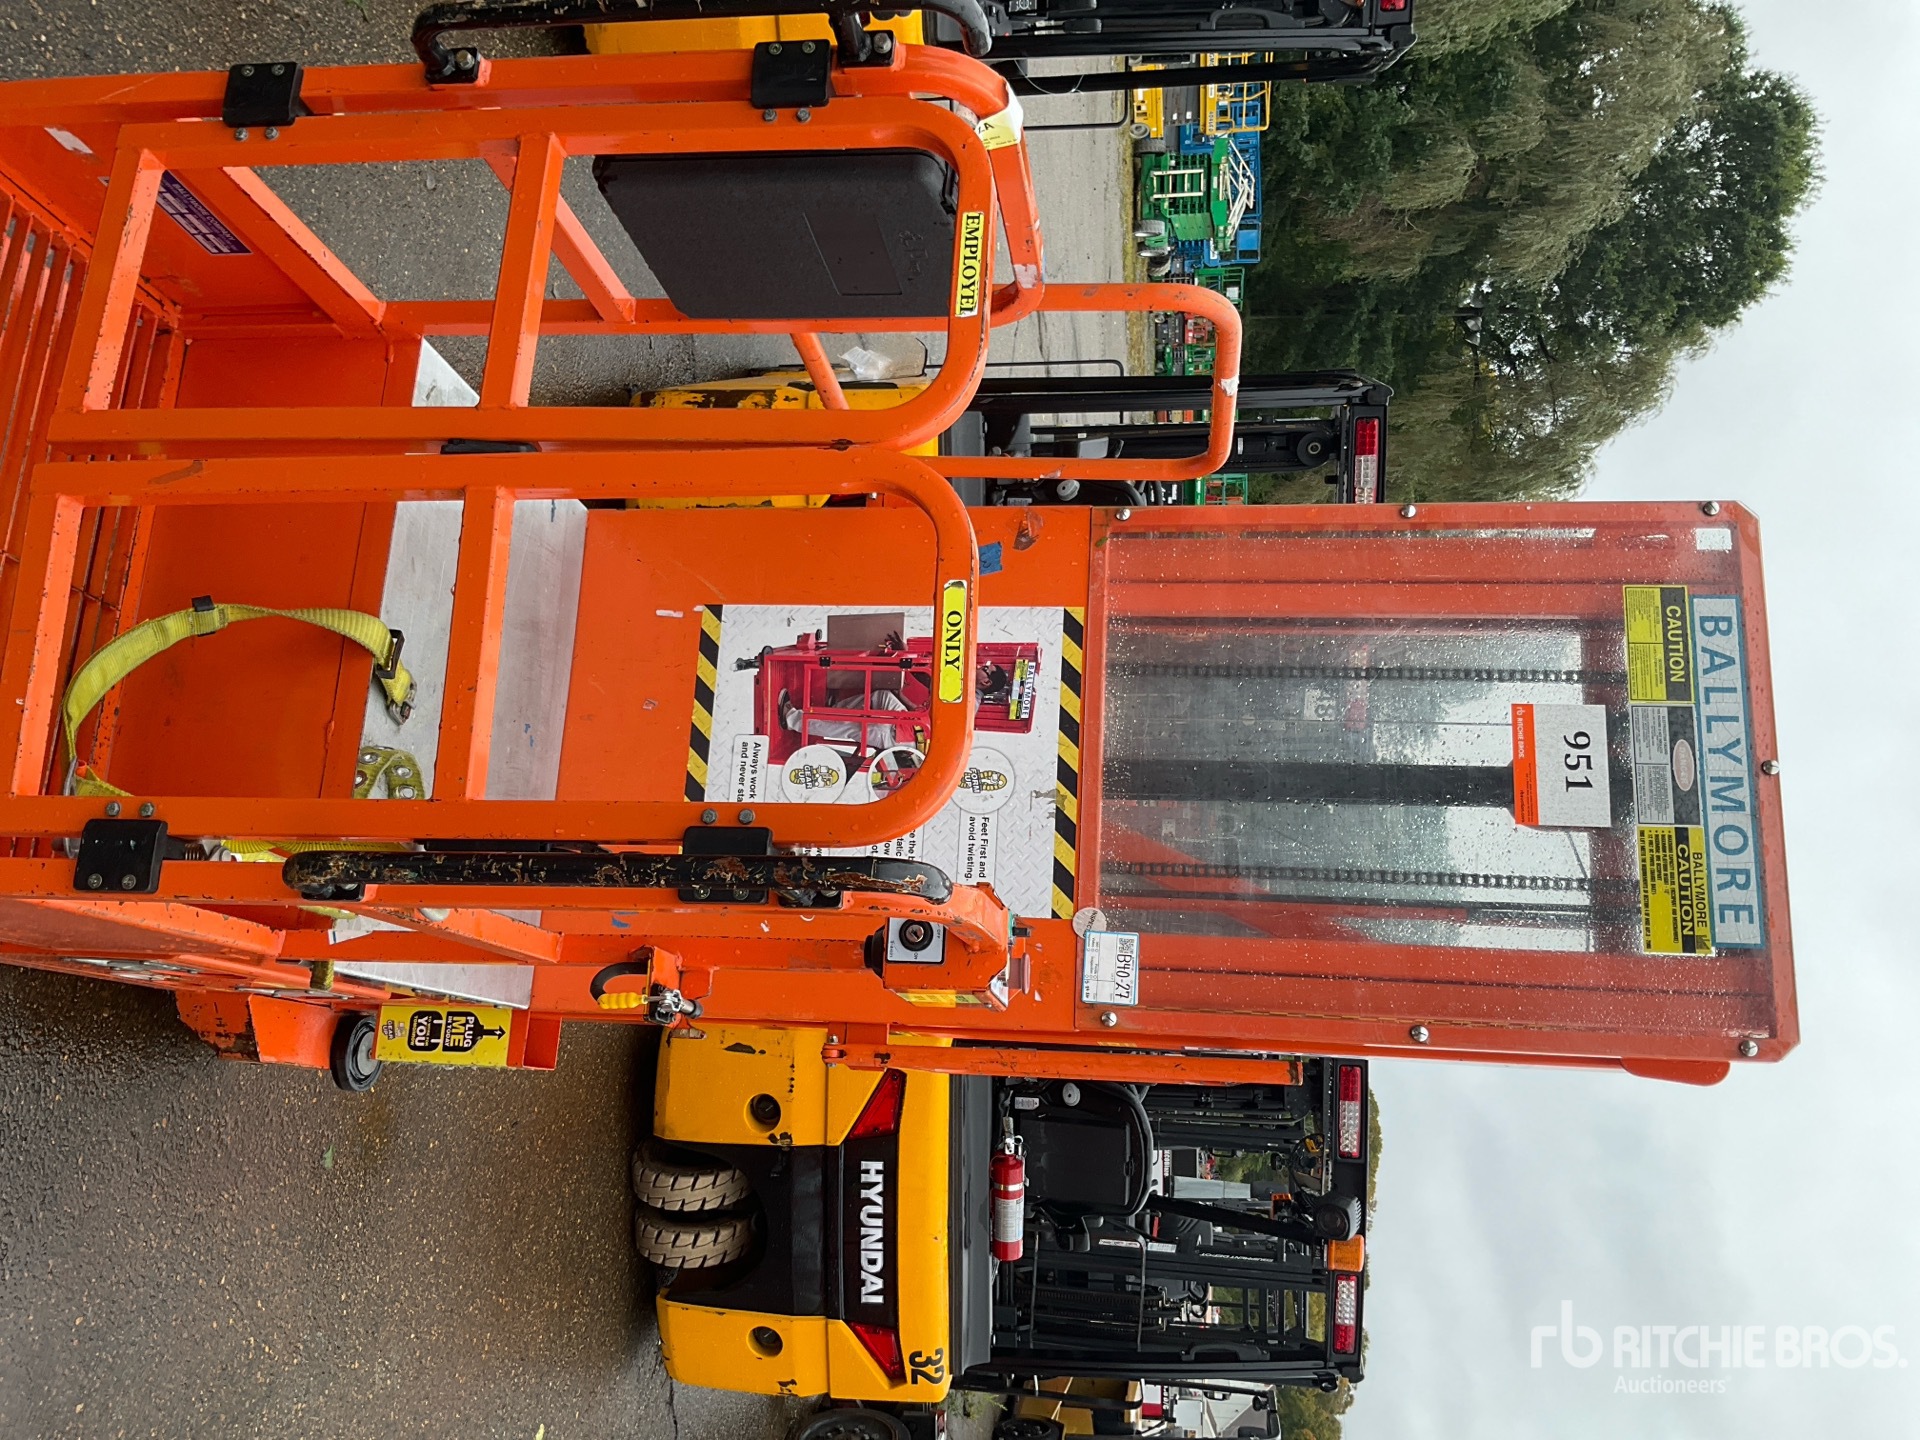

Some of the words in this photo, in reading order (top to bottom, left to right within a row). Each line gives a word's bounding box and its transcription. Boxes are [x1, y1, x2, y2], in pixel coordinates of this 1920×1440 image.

[945, 610, 962, 671] ONLY
[1666, 605, 1685, 682] CAUTION
[1022, 665, 1034, 716] BALLYMORE
[741, 742, 749, 758] and
[750, 742, 761, 774] Always
[1563, 731, 1593, 792] 951
[738, 761, 746, 786] never
[798, 772, 805, 783] UP
[804, 765, 812, 789] GEAR
[964, 776, 971, 788] UP
[970, 768, 980, 794] FORM
[1699, 615, 1754, 925] BALLYMORE
[749, 777, 757, 799] work
[968, 817, 976, 840] avoid
[981, 817, 989, 836] Feet
[896, 838, 904, 856] tatic
[908, 840, 916, 854] the
[964, 843, 974, 881] twisting.
[979, 838, 988, 859] First
[978, 861, 987, 878] and
[1677, 844, 1693, 935] CAUTION
[1692, 852, 1707, 928] BALLYMORE
[1115, 954, 1132, 999] B40-27
[382, 1025, 388, 1034] UP
[410, 1015, 418, 1046] TOMORROW
[415, 1016, 428, 1046] YOU
[444, 1024, 452, 1047] TODAY
[449, 1016, 466, 1047] ME
[464, 1016, 475, 1047] PLUG
[860, 1161, 884, 1304] HYUNDAI
[909, 1348, 944, 1385] 32
